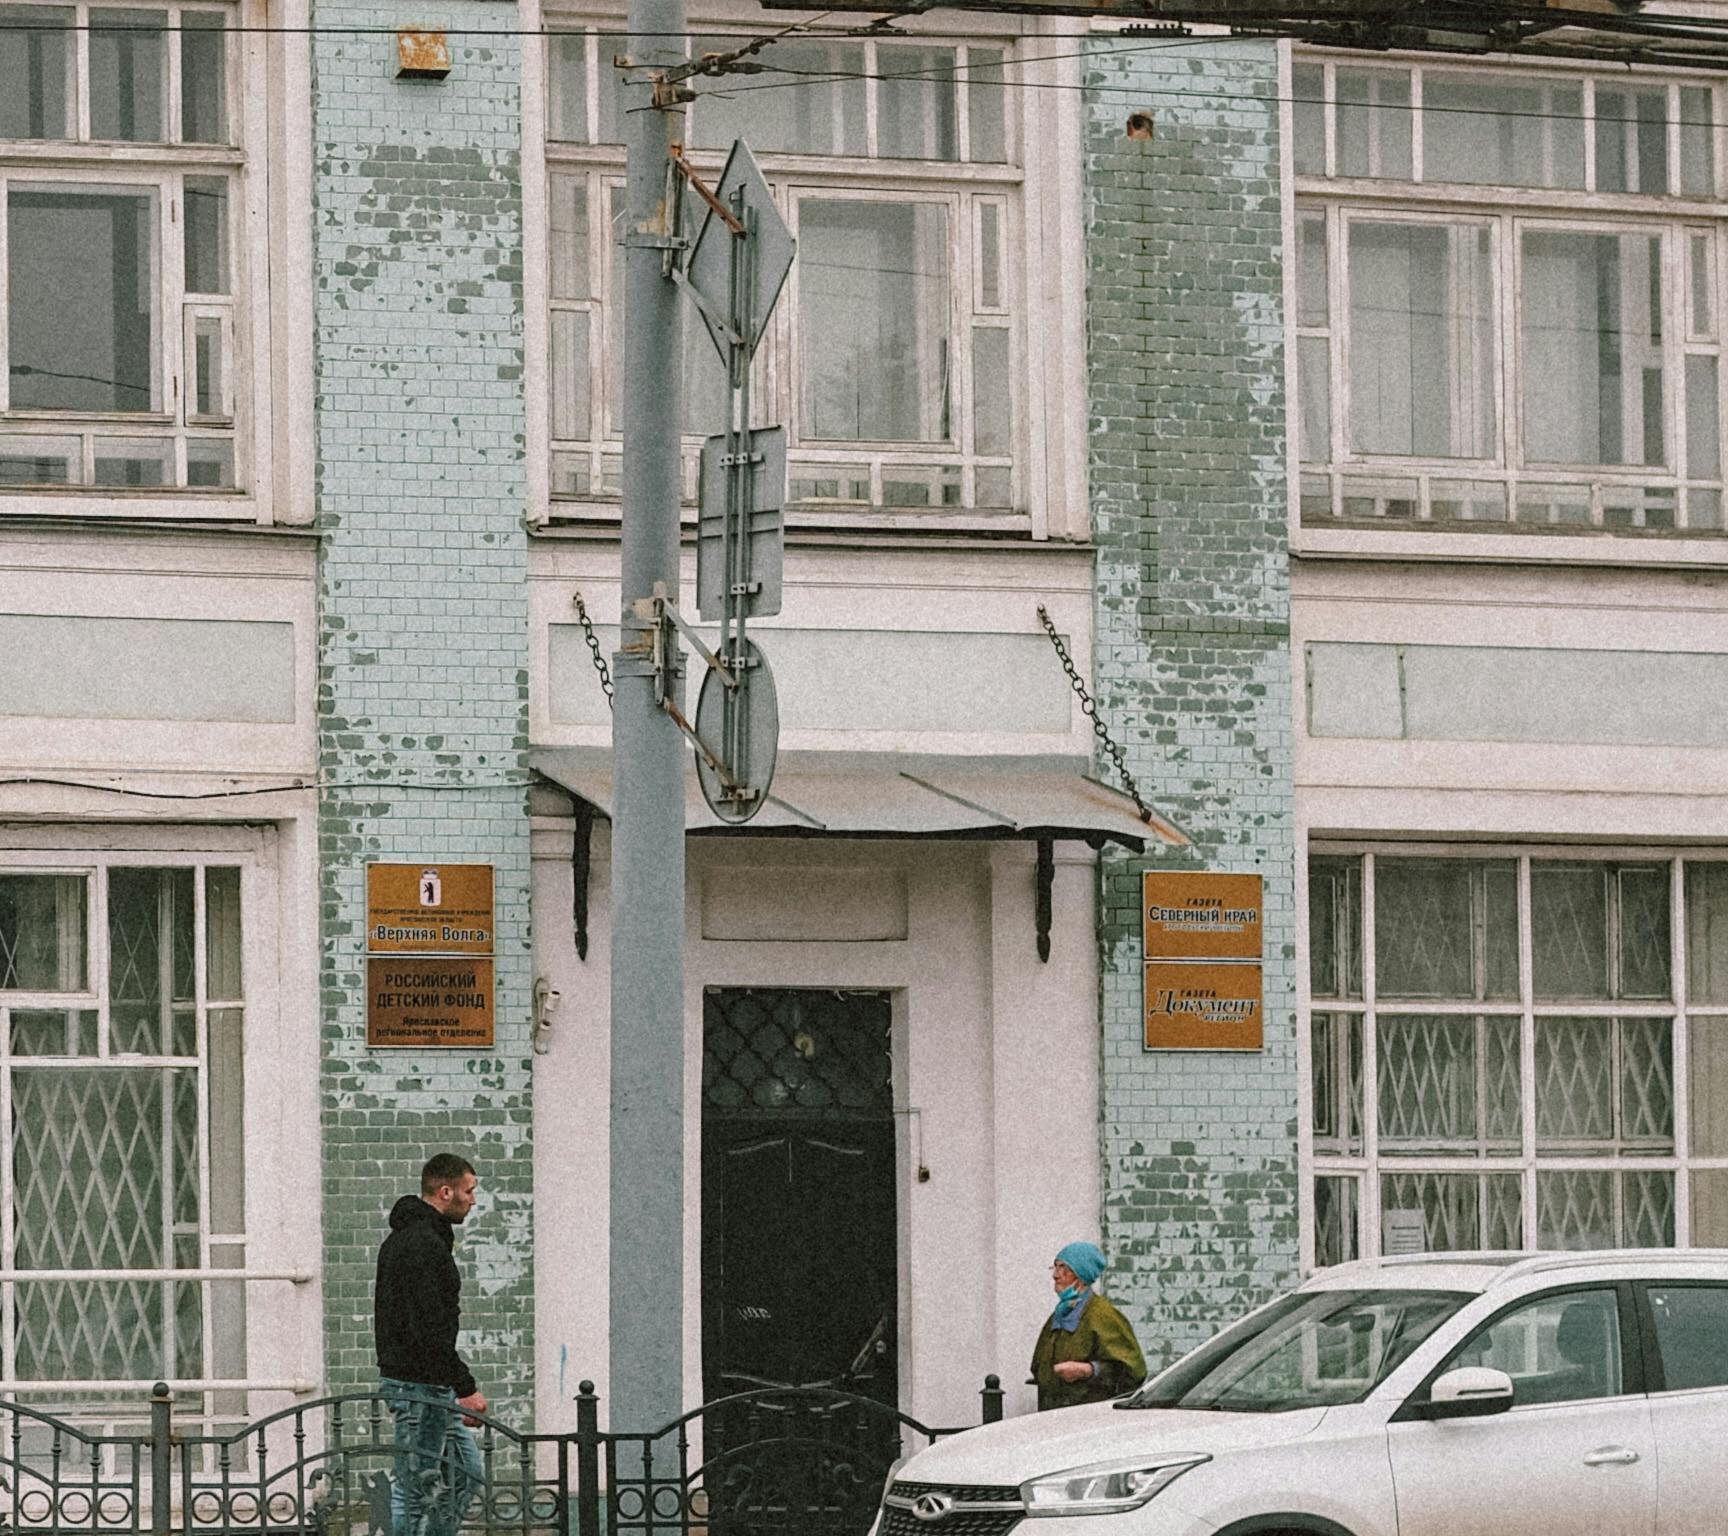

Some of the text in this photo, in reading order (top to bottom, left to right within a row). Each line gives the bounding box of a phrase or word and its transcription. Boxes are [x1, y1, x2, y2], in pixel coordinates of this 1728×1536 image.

[1186, 898, 1223, 906] ГАЗЕТА
[1149, 907, 1256, 923] СЕВЕРНЫЙ КРАЙ
[385, 972, 476, 988] РОССИЙСКИЙ
[377, 992, 486, 1009] ДЕТСКИЙ ФОНД
[403, 1016, 460, 1027] Ярославское
[376, 1028, 438, 1037] региональное
